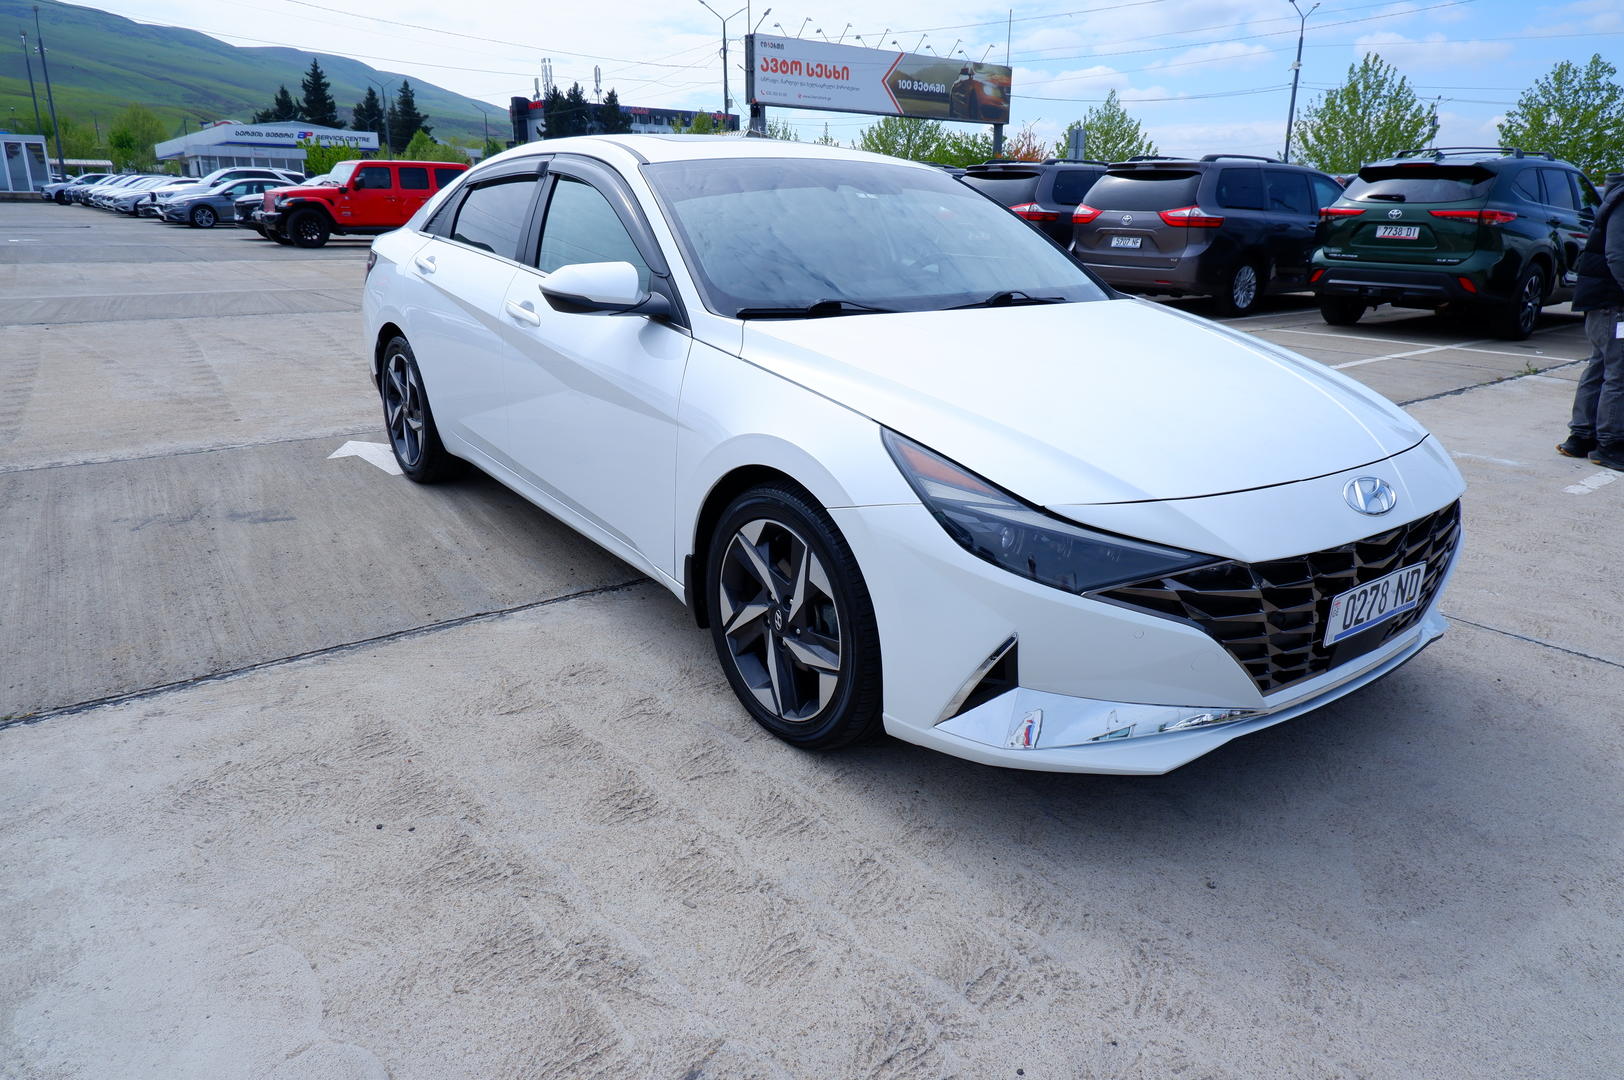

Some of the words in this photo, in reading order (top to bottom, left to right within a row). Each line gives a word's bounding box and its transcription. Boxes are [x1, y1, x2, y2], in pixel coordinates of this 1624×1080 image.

[760, 57, 802, 76] ავტო
[806, 62, 850, 80] სესხი
[898, 80, 911, 90] 100
[317, 134, 344, 142] SERVICE
[1342, 580, 1390, 630] 0278
[1394, 568, 1421, 608] ND
